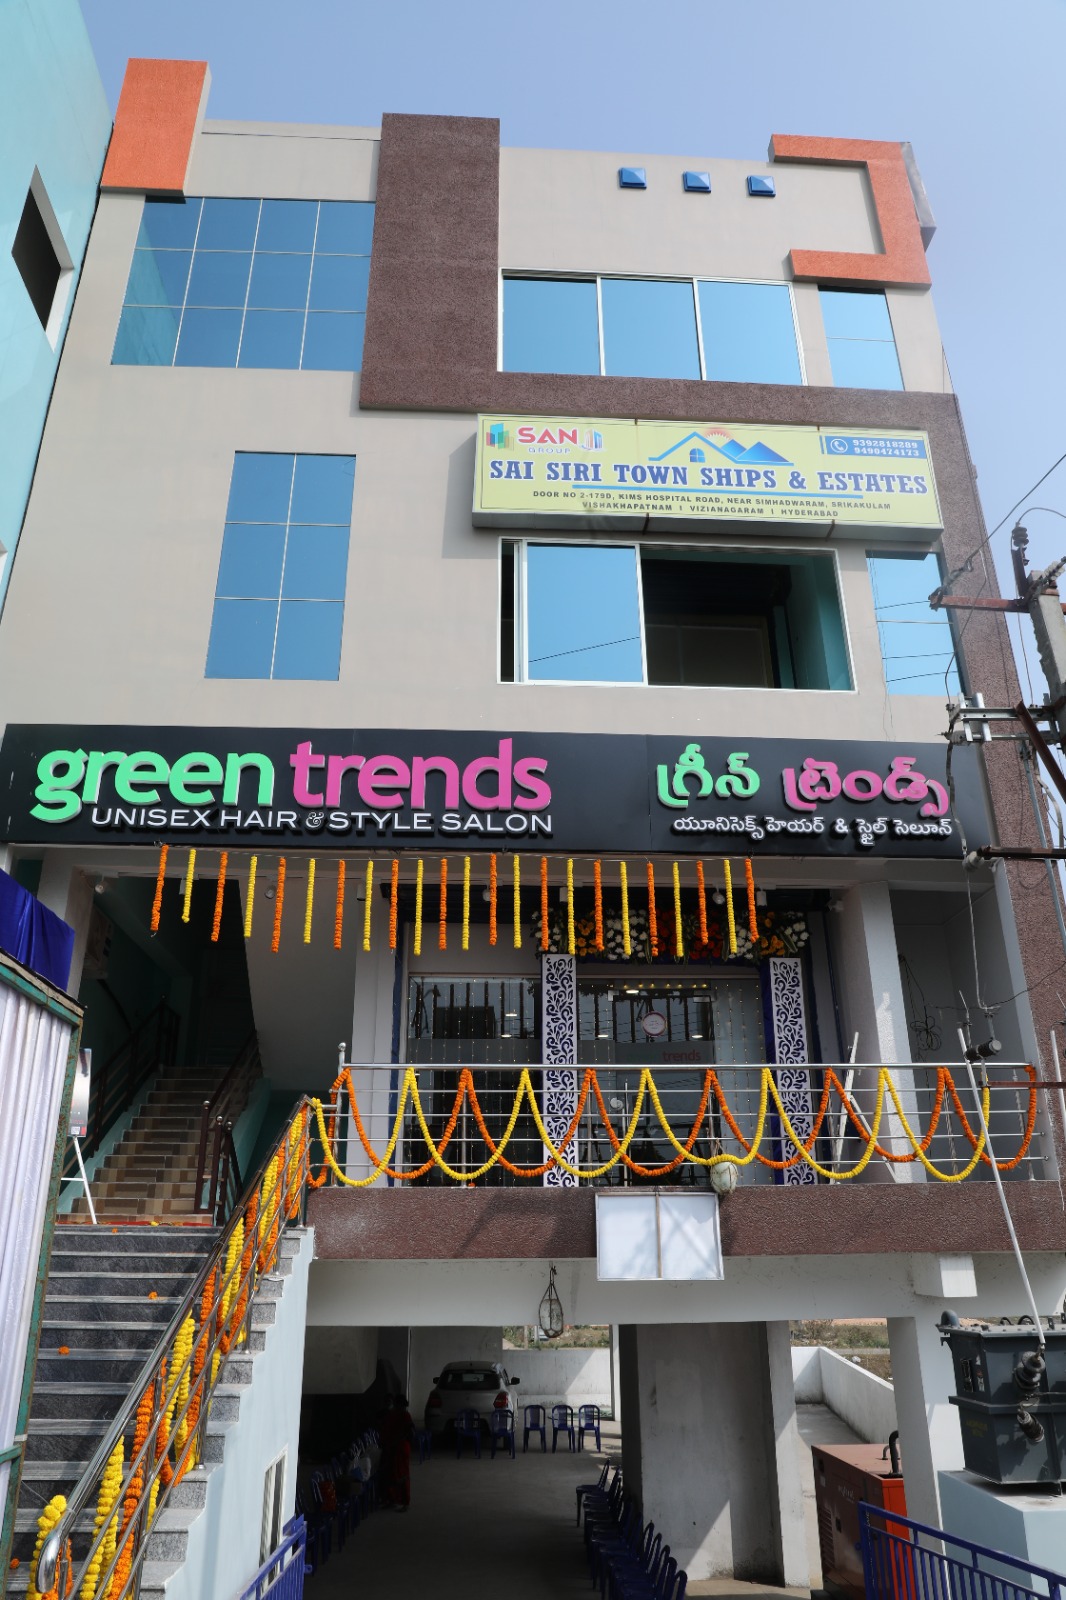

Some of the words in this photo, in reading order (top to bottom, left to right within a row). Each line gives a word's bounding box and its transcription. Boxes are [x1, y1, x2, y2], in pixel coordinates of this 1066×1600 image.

[517, 427, 578, 445] SAN
[527, 446, 571, 454] GROUP
[489, 460, 535, 480] SAI
[546, 462, 602, 482] SIRI
[613, 464, 689, 486] TOWN
[700, 467, 777, 489] SHIPS
[788, 470, 807, 490] &
[817, 471, 929, 494] ESTATES
[533, 490, 560, 498] DOOR
[618, 493, 643, 501] KIMS
[645, 494, 692, 503] HOSPITAL
[695, 496, 724, 504] ROAD,
[727, 497, 752, 505] NEAR
[755, 498, 828, 509] SIMHADWARAM,
[831, 501, 891, 510] SRIKAKULAM
[582, 501, 673, 511] VISHAKHAPATNAM
[690, 504, 765, 514] VIZIANAGARAM
[780, 508, 839, 517] HYDERABAD
[29, 748, 274, 823] green
[289, 738, 552, 811] trends
[657, 743, 761, 809] గ్రీన్
[91, 808, 212, 828] UNISEX
[220, 809, 298, 829] HAIR
[305, 811, 325, 829] &
[329, 811, 432, 831] STYLE
[441, 813, 552, 832] SALON
[835, 817, 849, 834] &
[662, 1049, 701, 1062] trends
